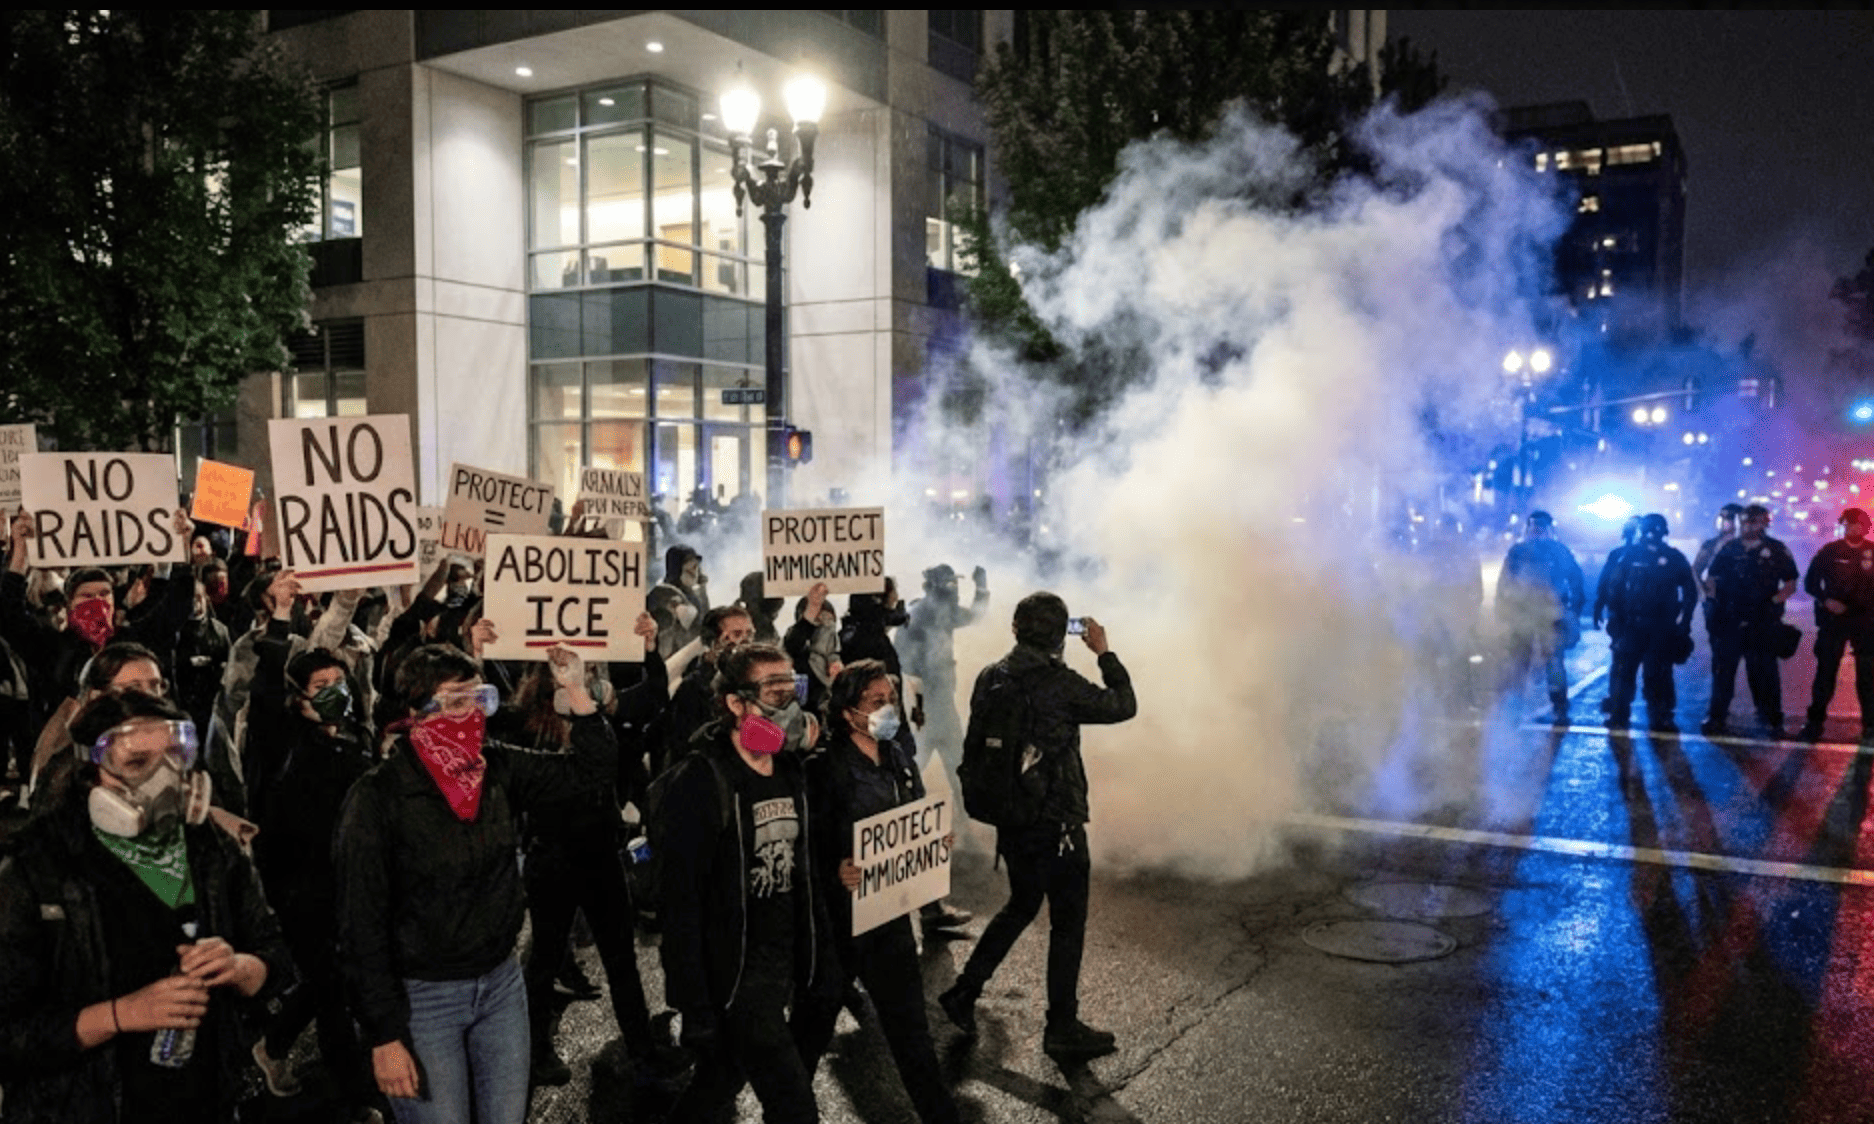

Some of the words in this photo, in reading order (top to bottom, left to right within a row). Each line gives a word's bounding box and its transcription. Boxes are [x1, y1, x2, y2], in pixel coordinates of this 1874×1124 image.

[302, 423, 383, 486] NO
[64, 458, 134, 501] NO
[455, 469, 549, 514] PROTECT
[34, 508, 173, 559] RAIDS
[280, 488, 416, 567] RAIDS
[769, 513, 881, 544] PROTECT
[494, 545, 639, 587] ABOLISH
[766, 549, 883, 582] IMMIGRANTS
[526, 596, 609, 637] ICE
[861, 801, 945, 860] PROTECT
[858, 836, 950, 900] IMMIGRANTS
